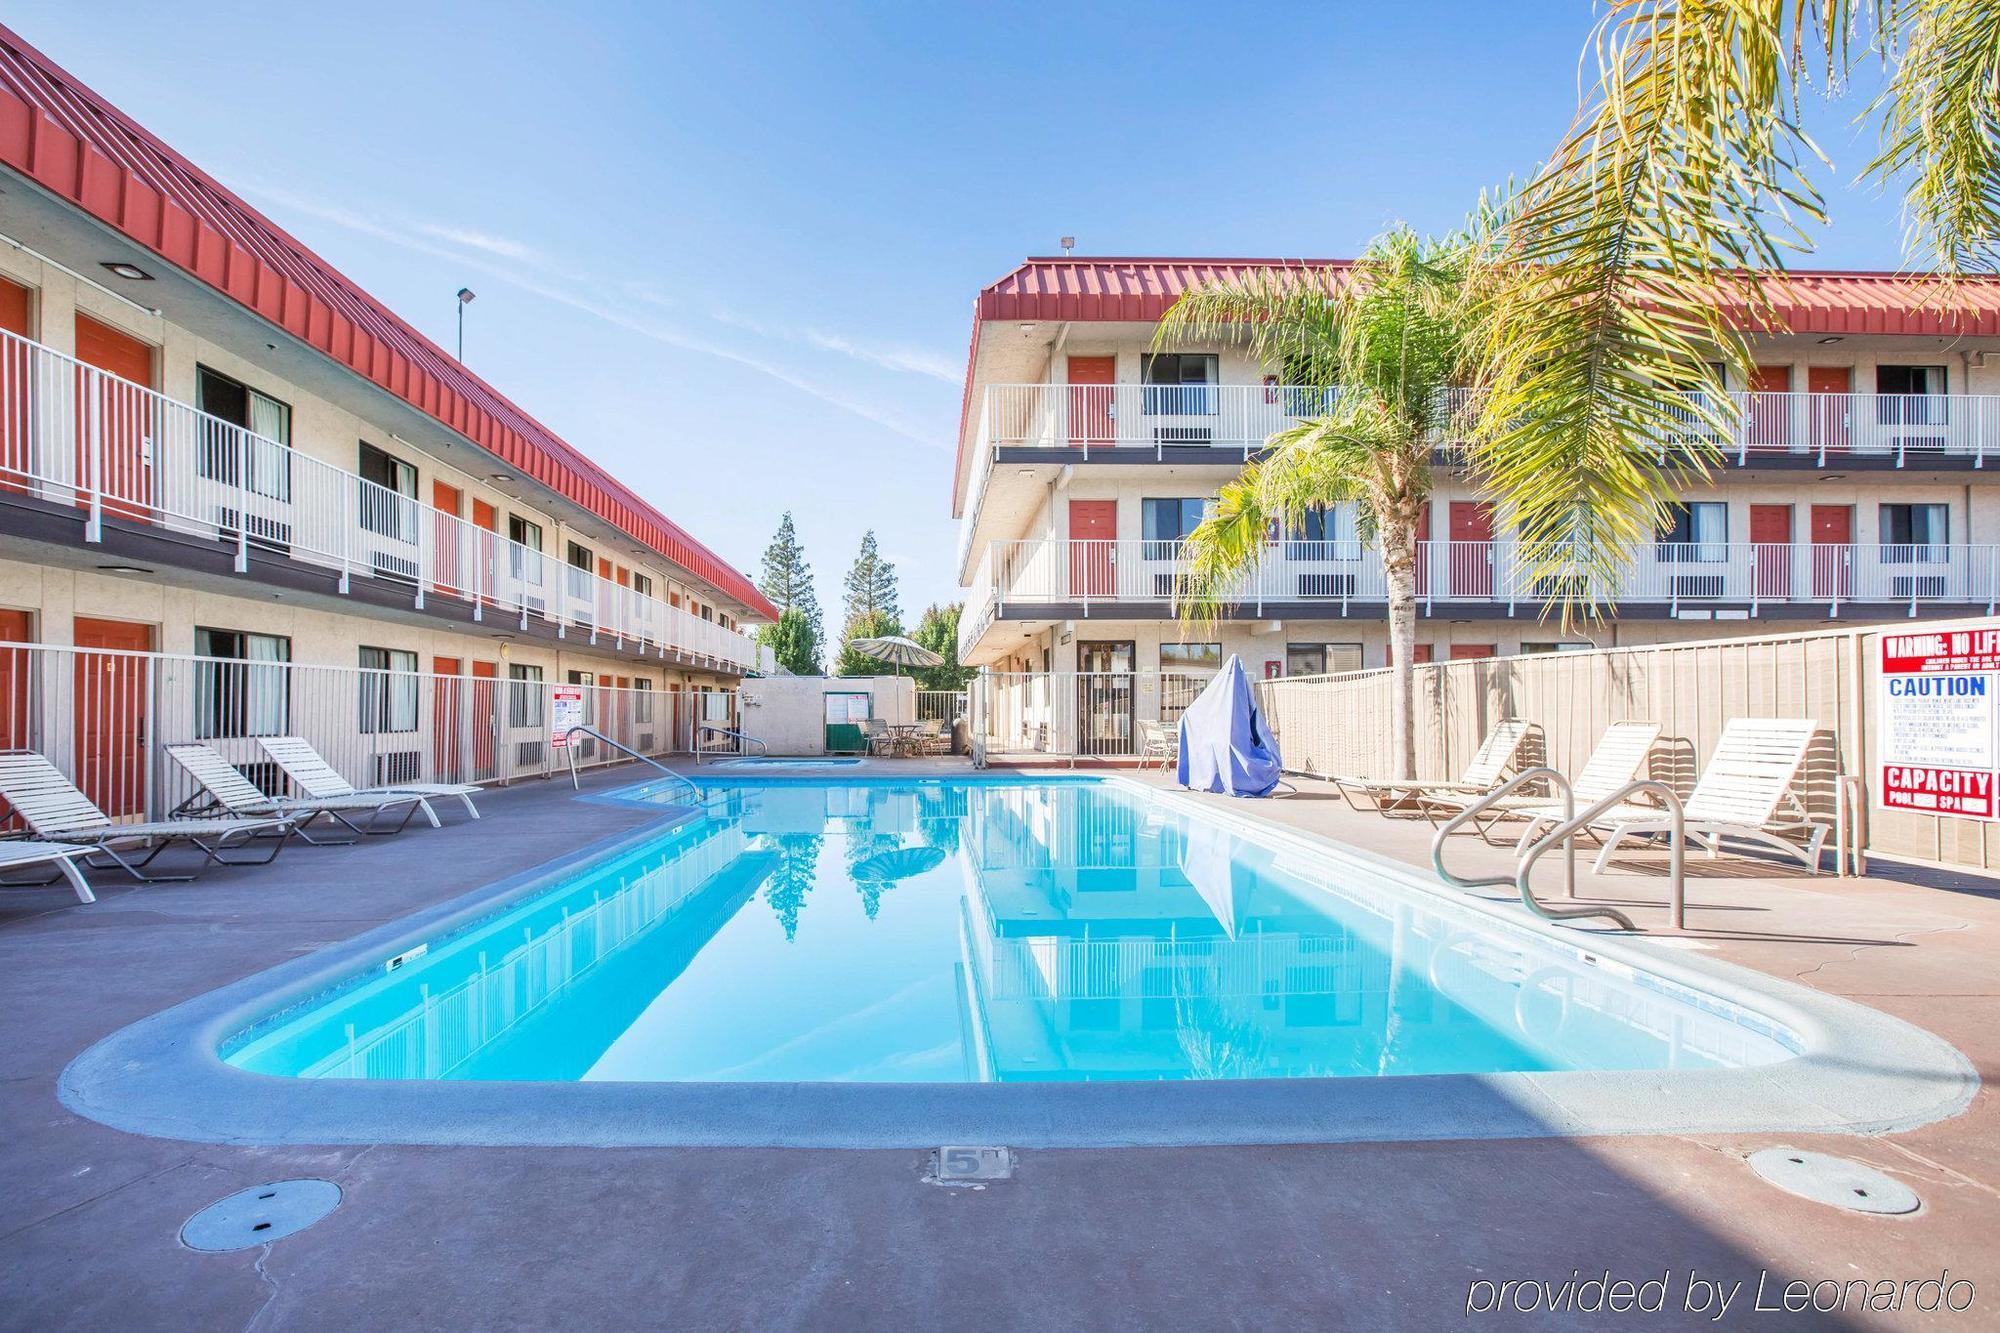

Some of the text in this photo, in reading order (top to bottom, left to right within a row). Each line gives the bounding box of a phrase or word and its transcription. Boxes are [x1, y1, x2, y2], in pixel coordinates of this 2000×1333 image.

[1886, 634, 1948, 658] WARNING:
[1952, 632, 1970, 655] NO
[1890, 677, 1985, 696] CAUTION
[1888, 767, 1989, 795] CAPACITY
[1889, 791, 1961, 810] POOL SPA
[946, 1149, 980, 1174] 5
